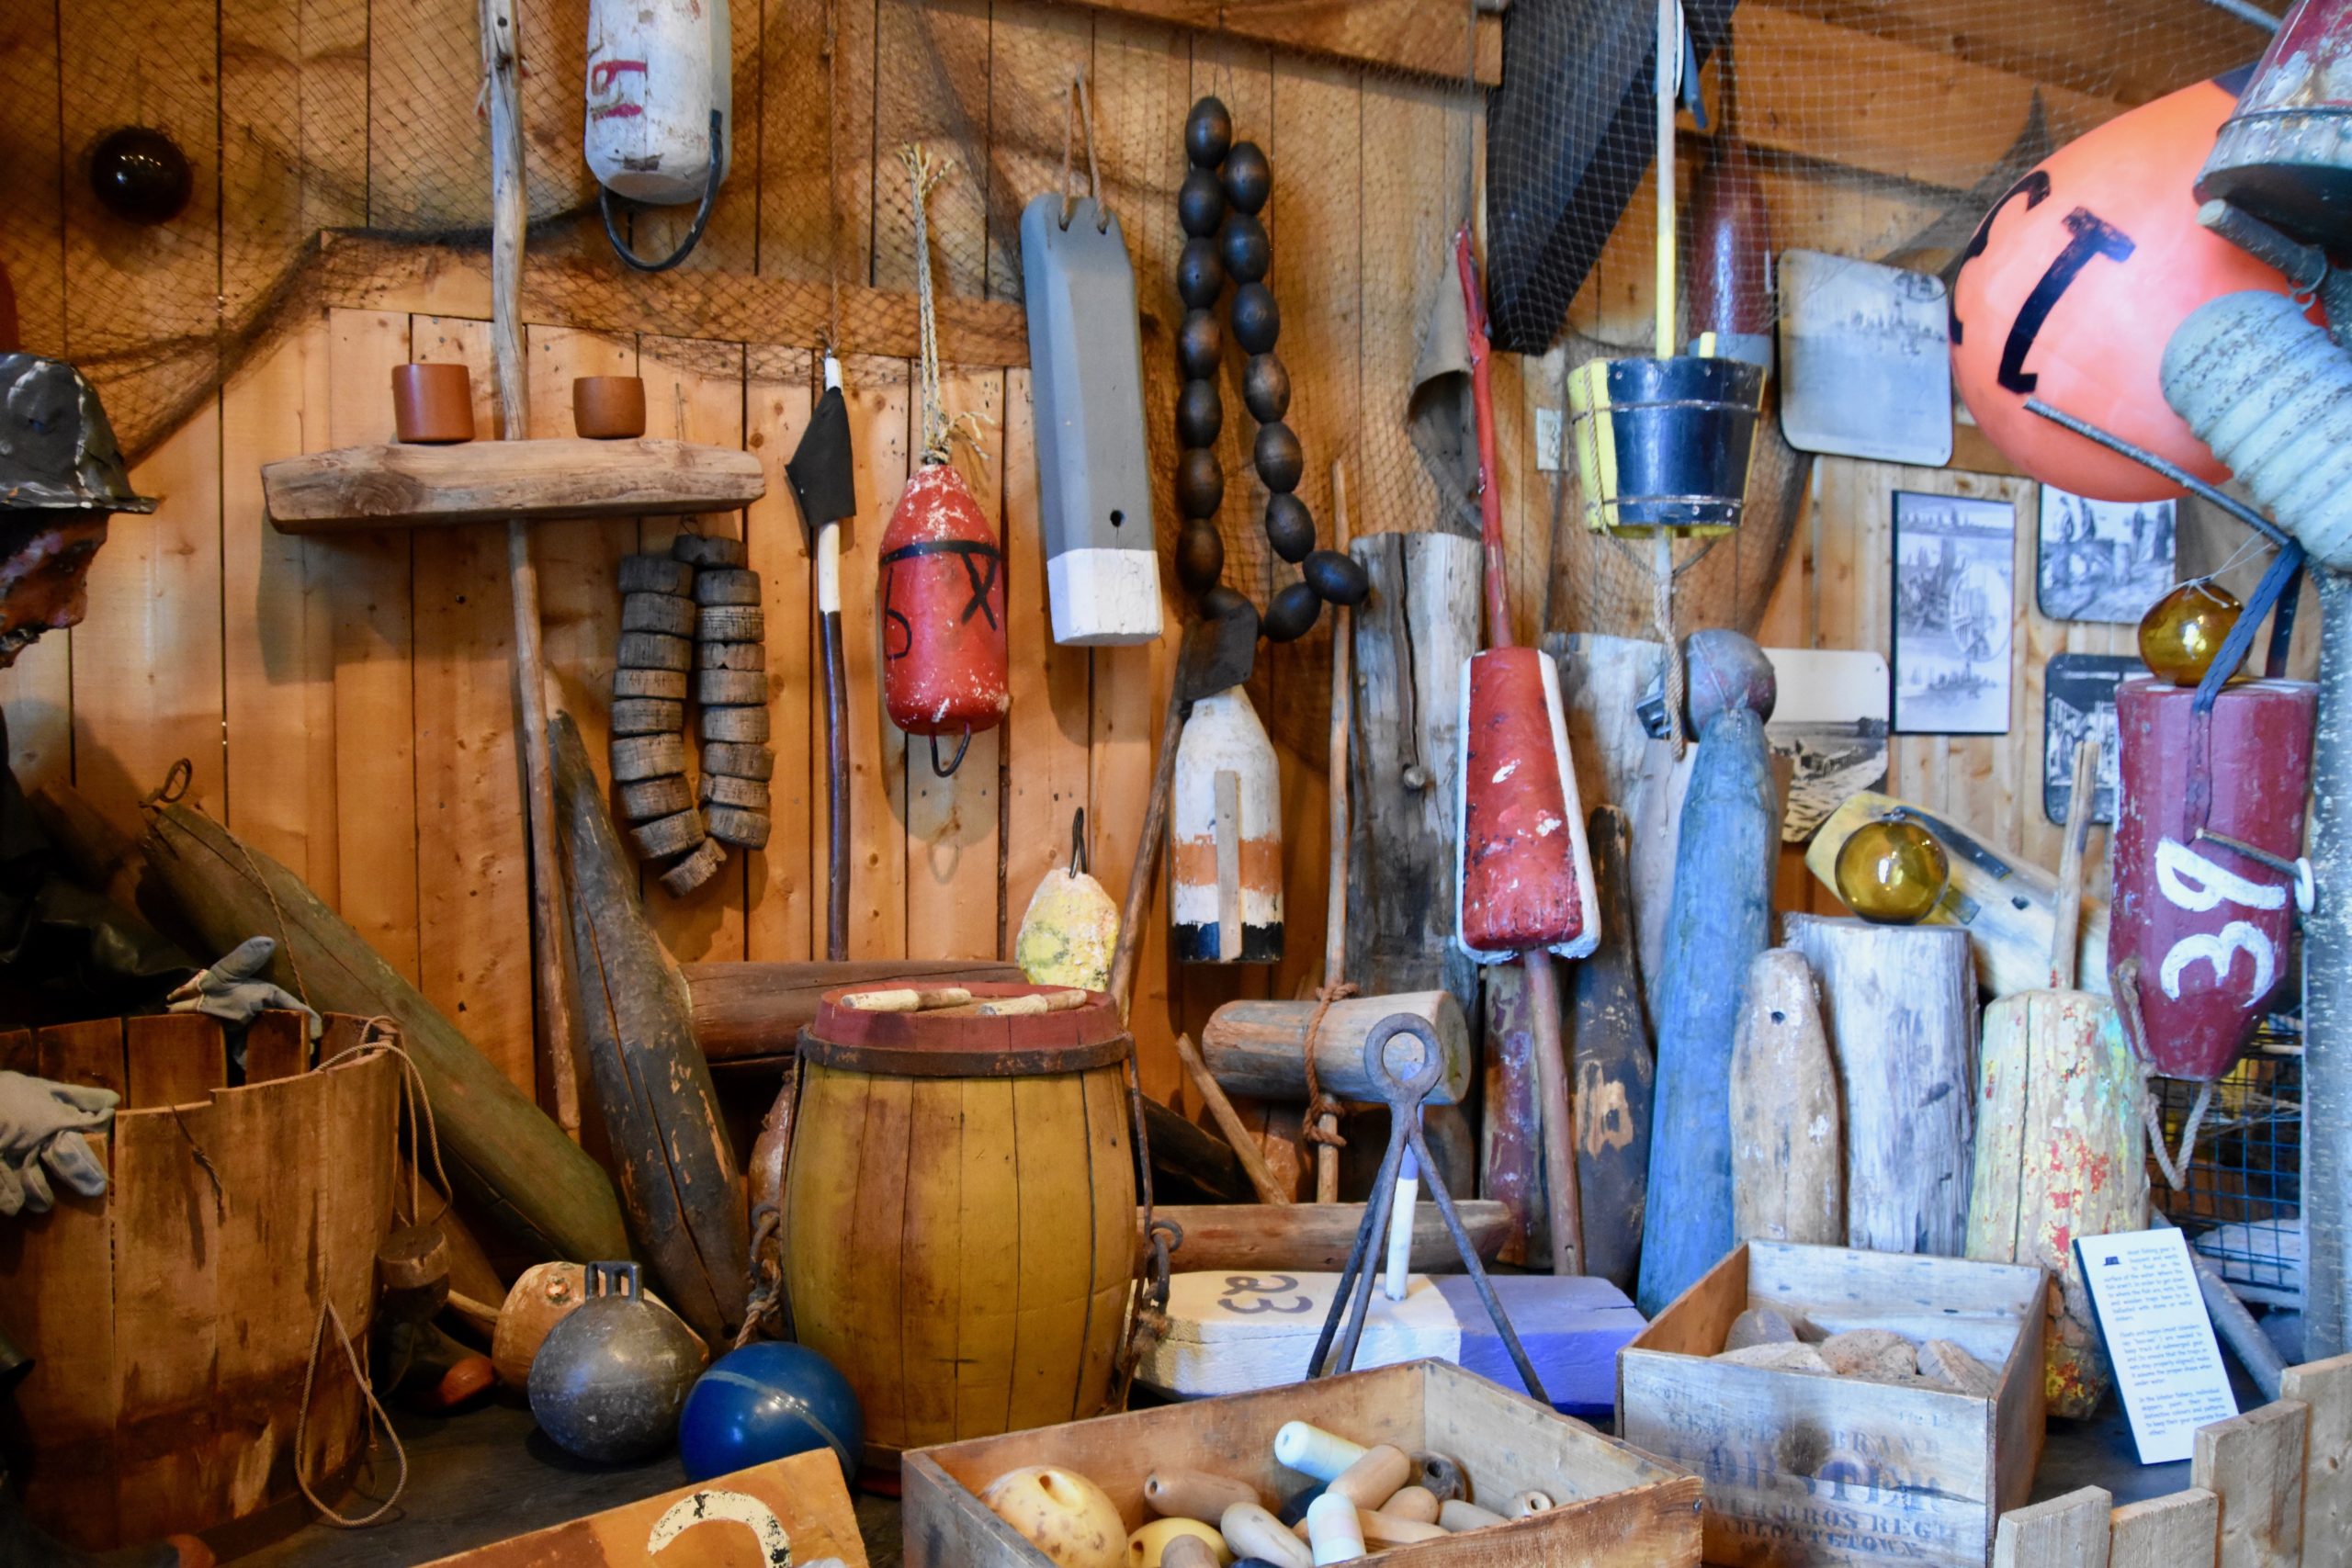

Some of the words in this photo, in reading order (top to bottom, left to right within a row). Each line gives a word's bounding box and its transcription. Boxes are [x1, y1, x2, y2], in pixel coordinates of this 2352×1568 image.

[2154, 836, 2287, 1009] 39
[1217, 1274, 1314, 1314] 23
[1781, 1504, 1858, 1529] BROS
